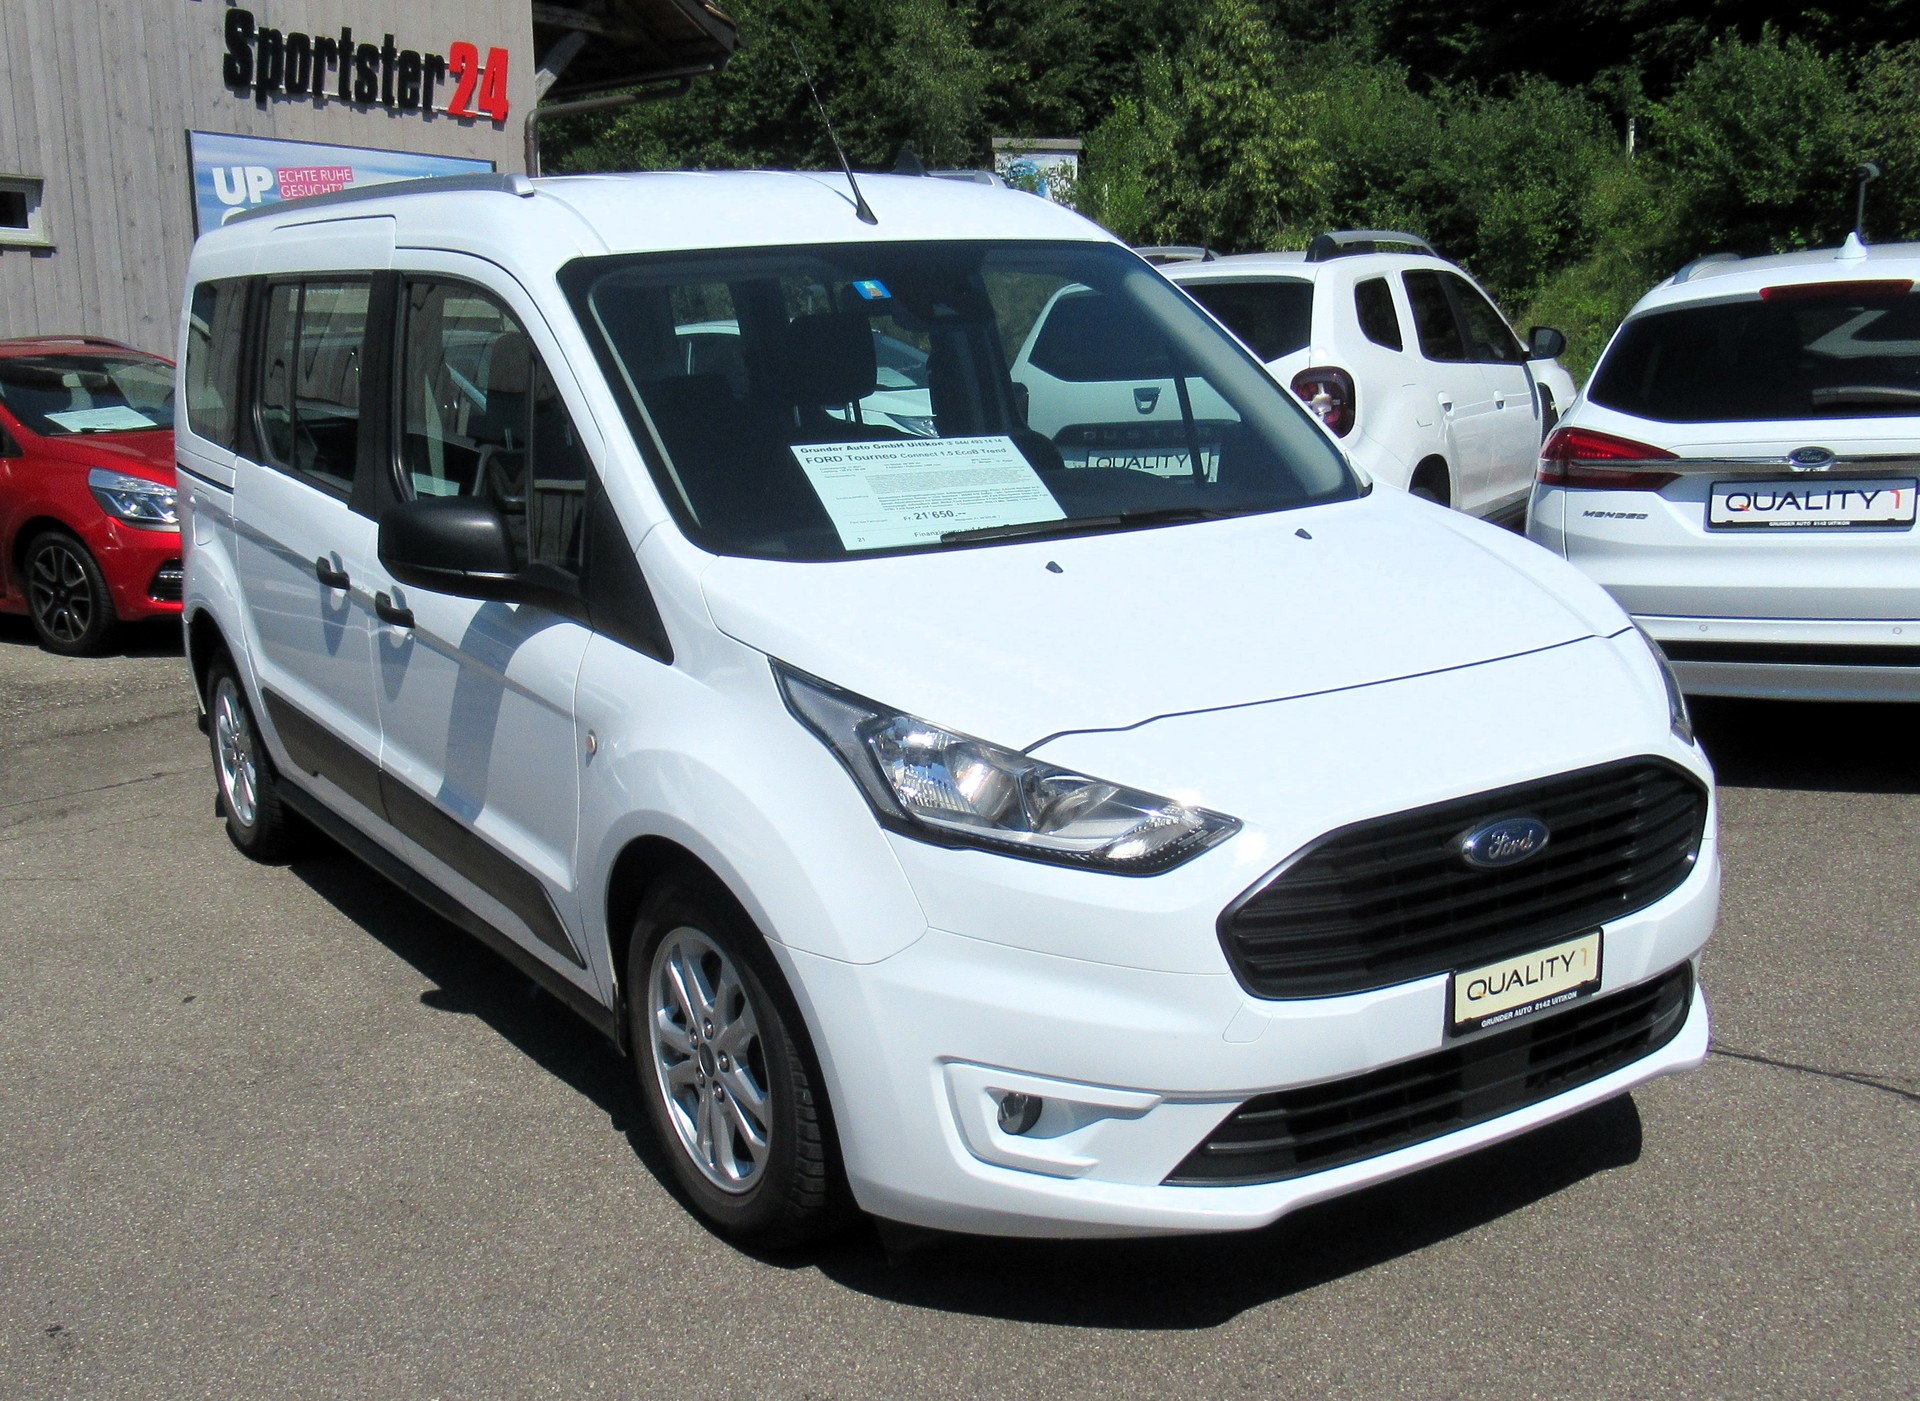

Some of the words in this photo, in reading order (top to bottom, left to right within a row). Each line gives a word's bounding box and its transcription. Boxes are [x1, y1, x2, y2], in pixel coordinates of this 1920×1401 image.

[278, 169, 317, 183] ECHTE
[320, 168, 353, 182] RUHE
[212, 166, 274, 205] UP
[280, 183, 343, 198] GESUCHT?
[805, 455, 843, 464] FORD
[845, 454, 897, 462] Tourneo
[1096, 454, 1190, 469] QUALITY
[1725, 489, 1882, 511] QUALITY
[1582, 510, 1648, 520] MONDEO
[1488, 829, 1534, 859] Ford
[1467, 950, 1576, 1001] QUALITY
[1481, 1011, 1514, 1028] GRUNDER
[1514, 1005, 1533, 1017] AUTO
[1535, 1000, 1551, 1011] 8142
